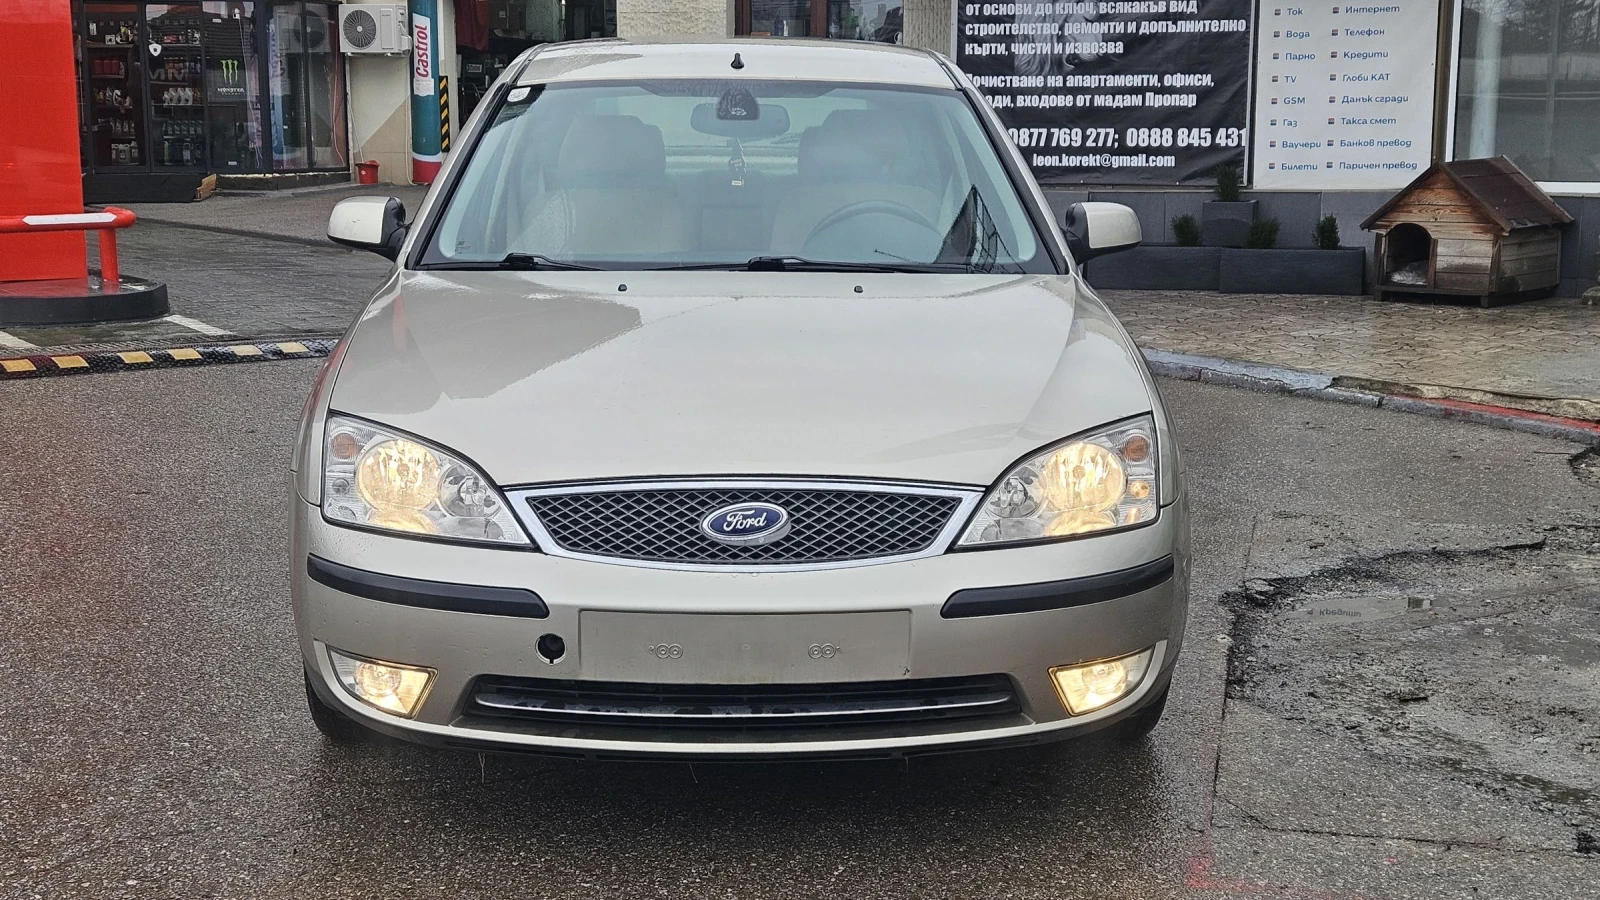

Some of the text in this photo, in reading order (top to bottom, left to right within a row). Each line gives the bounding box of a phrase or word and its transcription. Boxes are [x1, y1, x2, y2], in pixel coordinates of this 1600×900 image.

[966, 0, 1198, 17] от основи до ключ, всякакъв вид
[1345, 5, 1400, 14] Интернет
[965, 19, 1246, 37] строителство, ремонти и допълнително
[1345, 28, 1385, 37] Телефон
[1286, 30, 1310, 39] Вода
[415, 24, 429, 78] Castrol
[965, 41, 1124, 56] кърти, чисти и извозва
[1285, 53, 1316, 62] Парно
[1343, 51, 1389, 60] Кредити
[1047, 75, 1064, 87] на
[1066, 75, 1161, 88] апартаменти,
[1163, 73, 1215, 87] офиси,
[1343, 73, 1390, 82] Глоби КАТ
[1016, 95, 1074, 109] входове
[1076, 95, 1092, 107] от
[1094, 94, 1143, 109] мадам
[1145, 92, 1197, 108] Пропар
[1284, 97, 1306, 105] GSM
[1342, 95, 1409, 104] Данък сгради
[1283, 119, 1298, 127] Газ
[1341, 117, 1368, 125] Такса
[1050, 128, 1083, 147] 769
[1086, 128, 1119, 149] 277;
[1126, 127, 1173, 147] 0888
[1177, 127, 1212, 147] 845
[1215, 127, 1246, 147] 431
[1282, 141, 1322, 150] Ваучери
[1340, 139, 1412, 148] Банков превод
[1033, 153, 1176, 169] leon.korekt@gmail.com
[1339, 161, 1418, 170] Паричен превод
[1281, 163, 1318, 171] Билети
[723, 510, 767, 531] Ford
